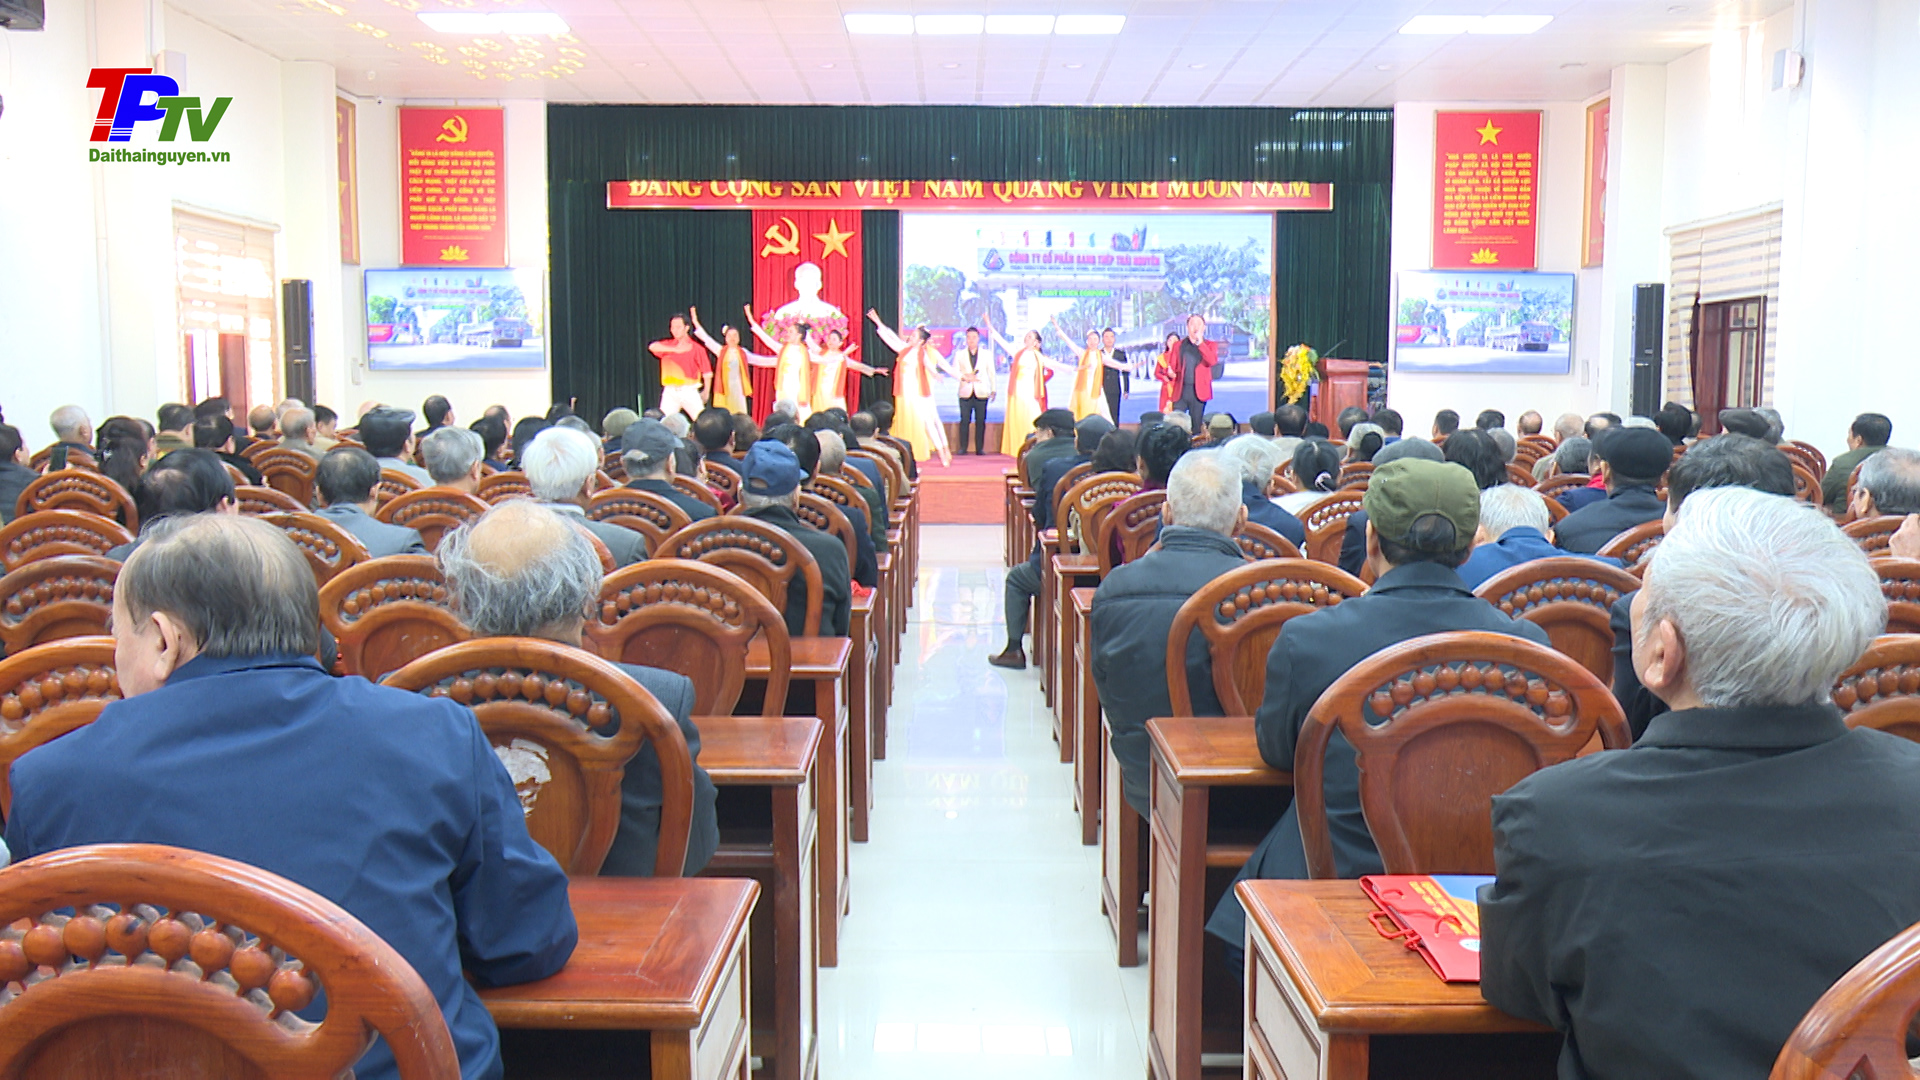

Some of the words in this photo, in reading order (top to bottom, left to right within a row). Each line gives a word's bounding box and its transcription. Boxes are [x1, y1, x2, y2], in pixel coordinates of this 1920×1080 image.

[923, 181, 985, 198] NAM
[992, 180, 1084, 203] QUANG
[1092, 181, 1160, 198] VINH
